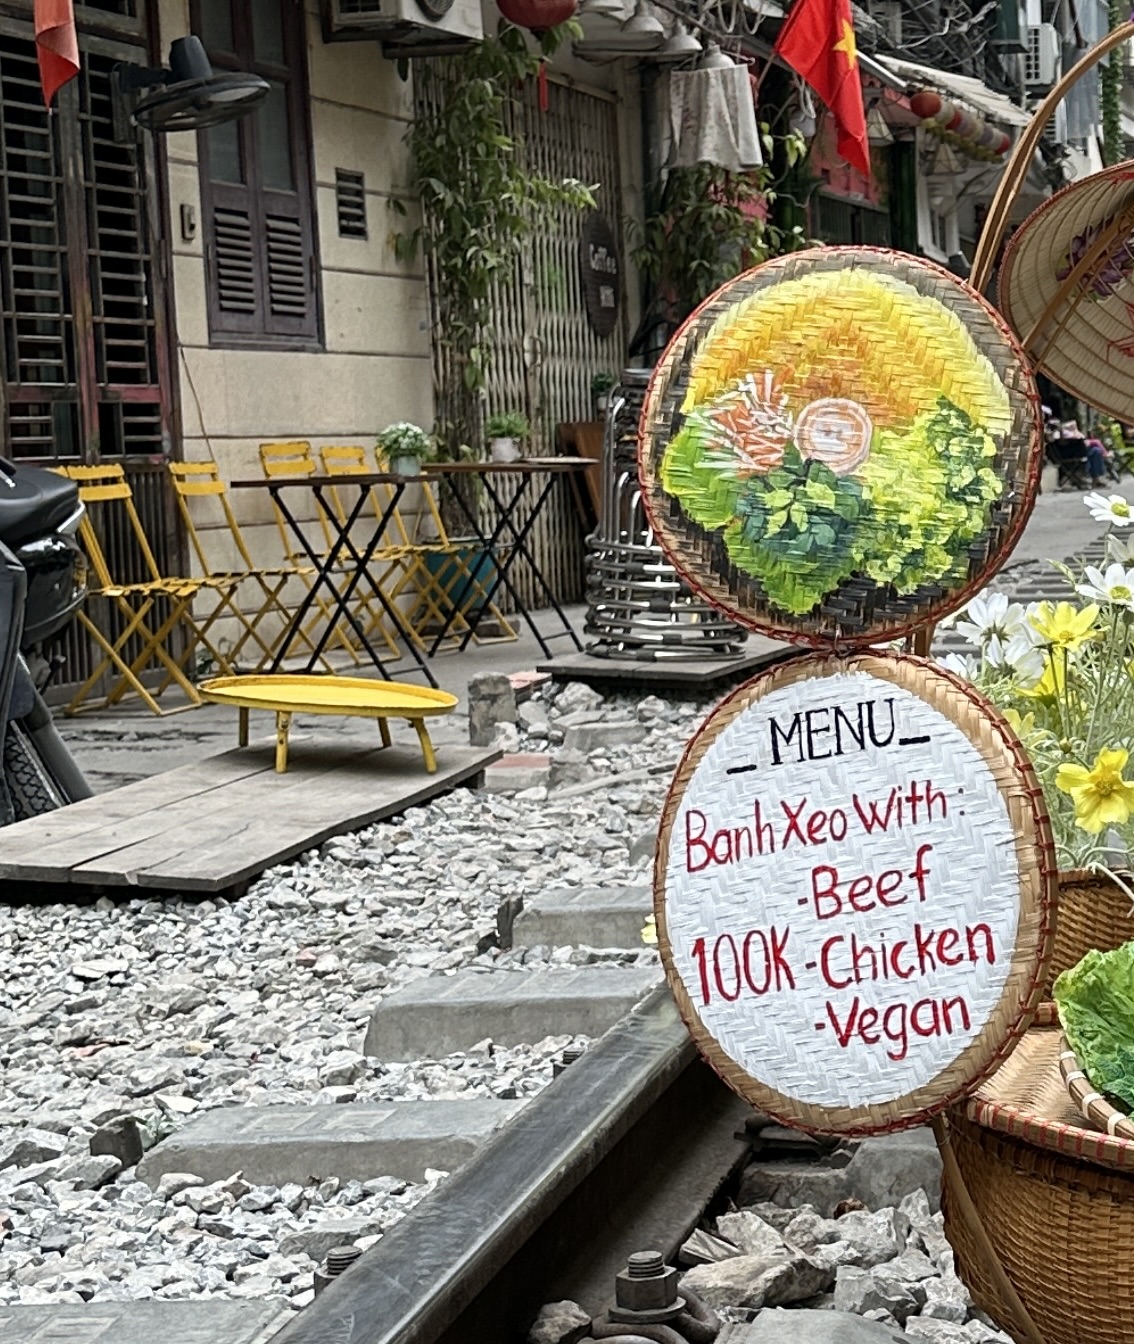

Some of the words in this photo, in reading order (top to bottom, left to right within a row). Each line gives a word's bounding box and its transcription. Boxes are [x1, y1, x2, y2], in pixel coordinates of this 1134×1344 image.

[685, 799, 778, 874] Banh
[780, 799, 849, 851] Xeo
[691, 925, 796, 1007] 100K
